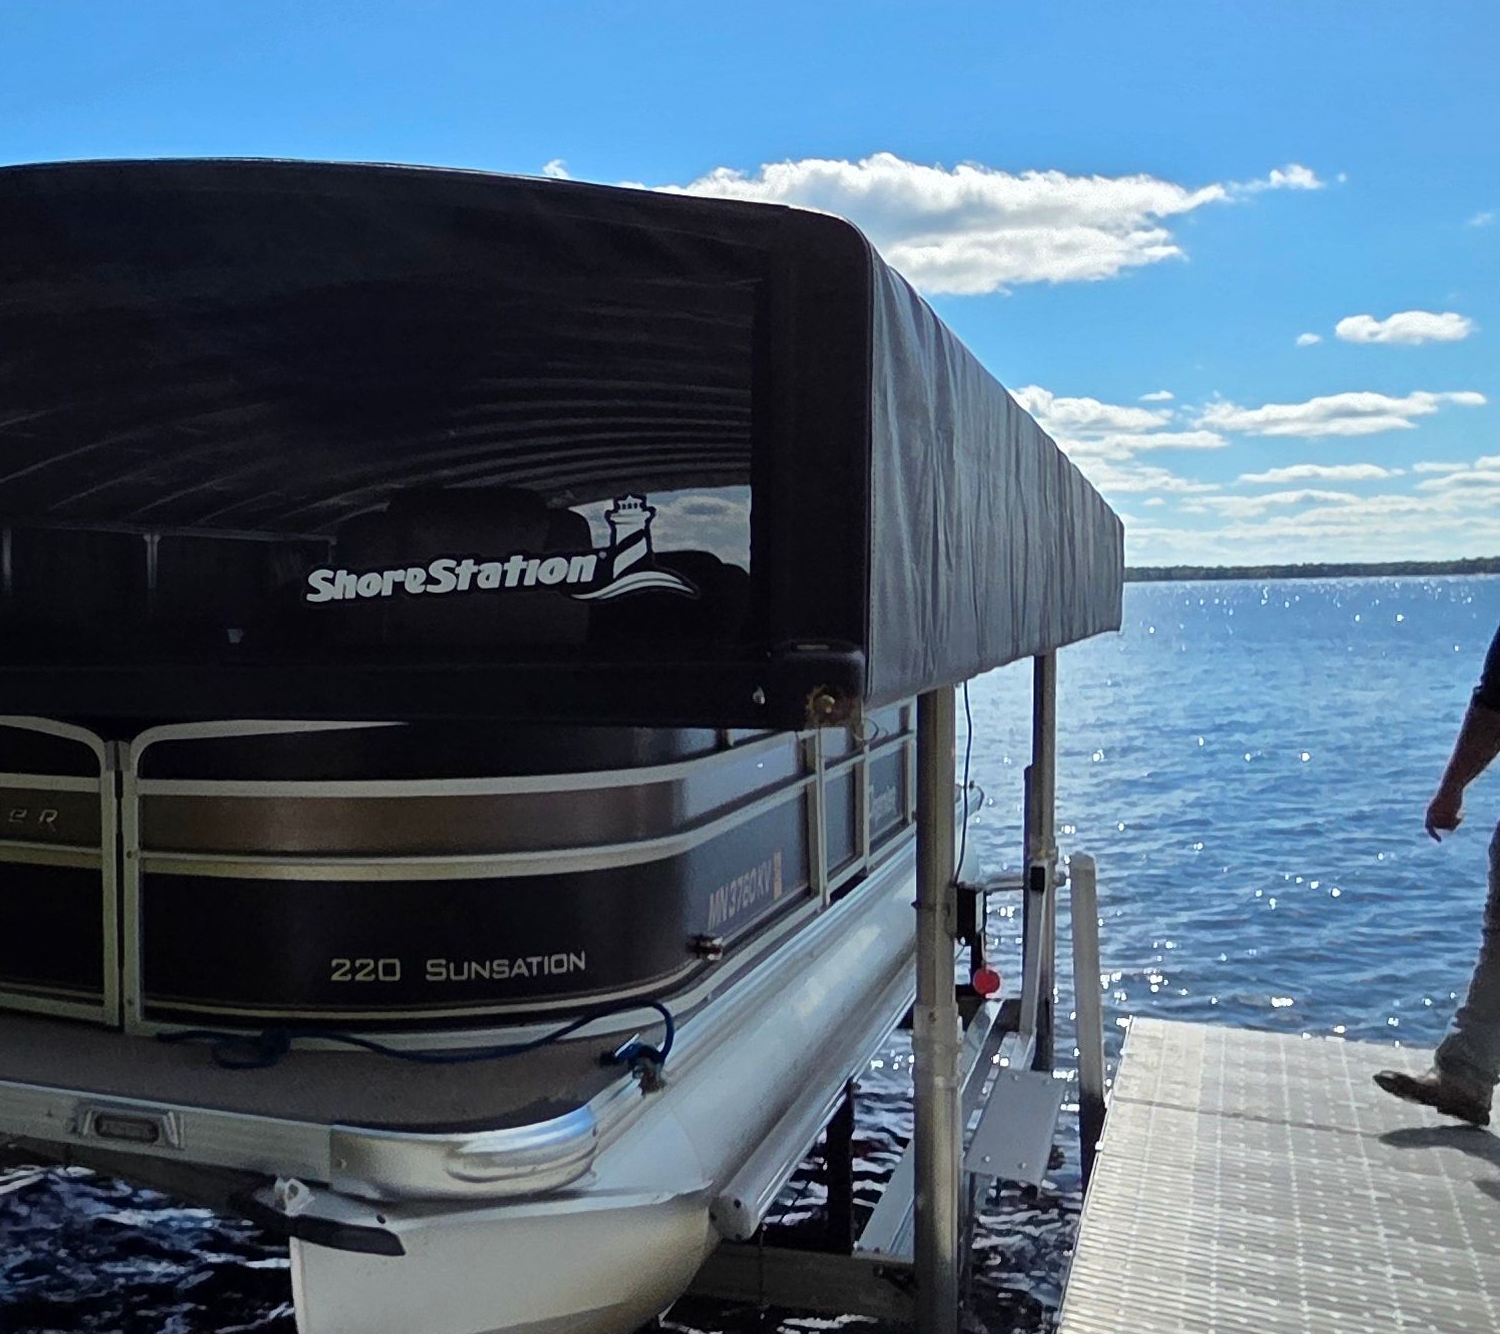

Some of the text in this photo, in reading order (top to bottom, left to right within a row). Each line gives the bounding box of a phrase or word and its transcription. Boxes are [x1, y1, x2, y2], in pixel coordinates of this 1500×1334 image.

[306, 552, 597, 603] ShoreStation
[331, 950, 587, 982] 220 SUNSATION
